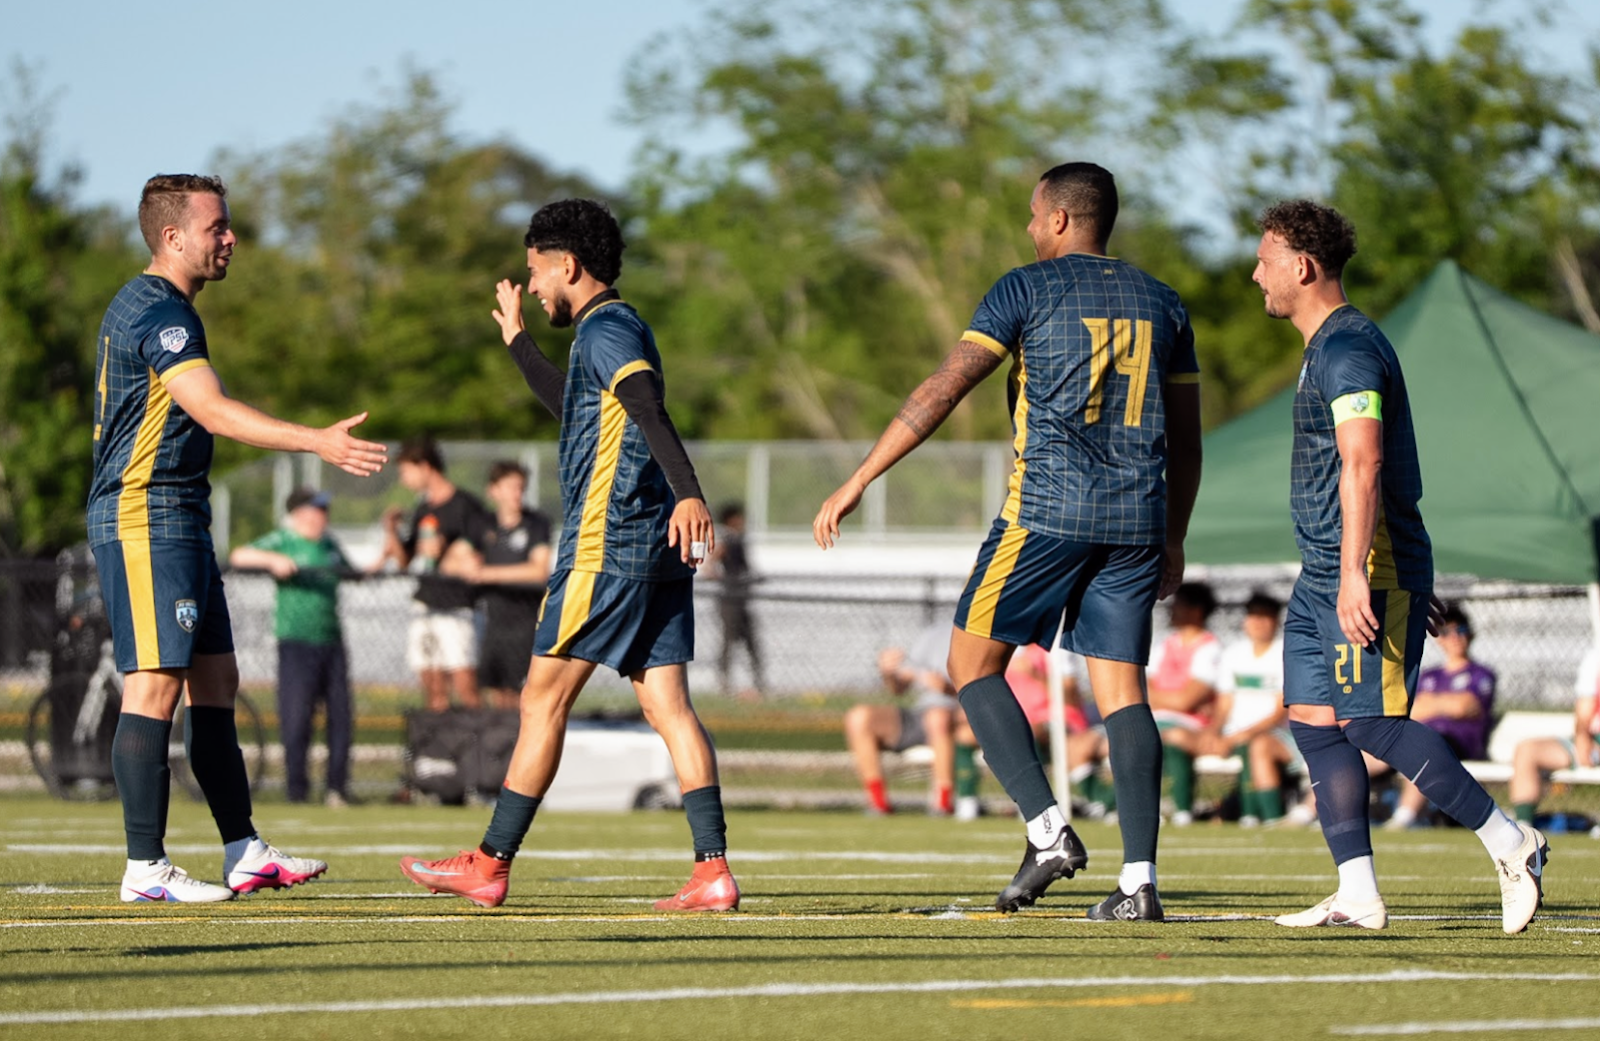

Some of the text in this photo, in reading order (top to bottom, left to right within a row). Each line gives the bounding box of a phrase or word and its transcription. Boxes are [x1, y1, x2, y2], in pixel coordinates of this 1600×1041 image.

[162, 330, 187, 349] UPSL
[1082, 317, 1152, 427] 14
[1334, 643, 1362, 684] 21
